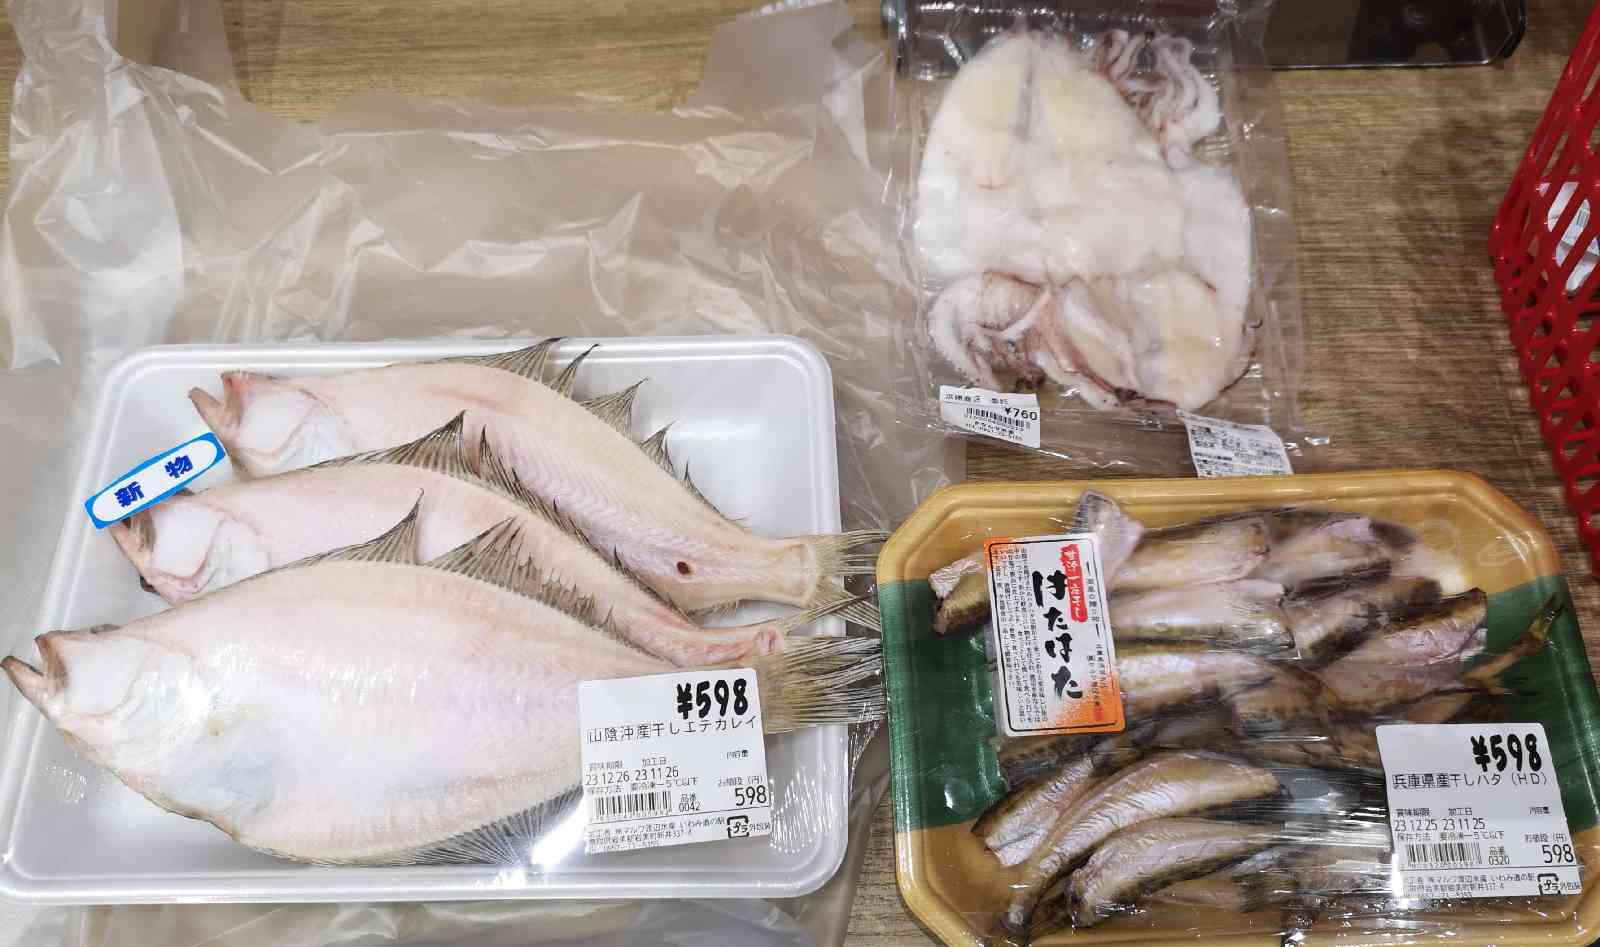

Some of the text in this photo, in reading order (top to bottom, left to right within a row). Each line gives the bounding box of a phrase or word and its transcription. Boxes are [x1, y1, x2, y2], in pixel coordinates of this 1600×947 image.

[1005, 406, 1038, 421] ¥760
[114, 454, 194, 508] 新物
[1031, 569, 1084, 700] はたはた
[676, 678, 749, 720] ¥598
[586, 715, 758, 743] 山陰沖産干しエテカレイ
[1470, 732, 1543, 773] ¥598
[641, 756, 667, 768] 加工日
[585, 766, 679, 786] 23 12 26 23 11 26
[735, 785, 767, 806] 598
[678, 801, 702, 813] 0042
[1448, 807, 1473, 816] 加工日
[733, 821, 748, 834] プラ
[1394, 818, 1485, 832] 23 12 25 23 11 25
[1488, 855, 1510, 866] 0320
[1542, 844, 1574, 864] 598
[1543, 879, 1559, 891] プラ
